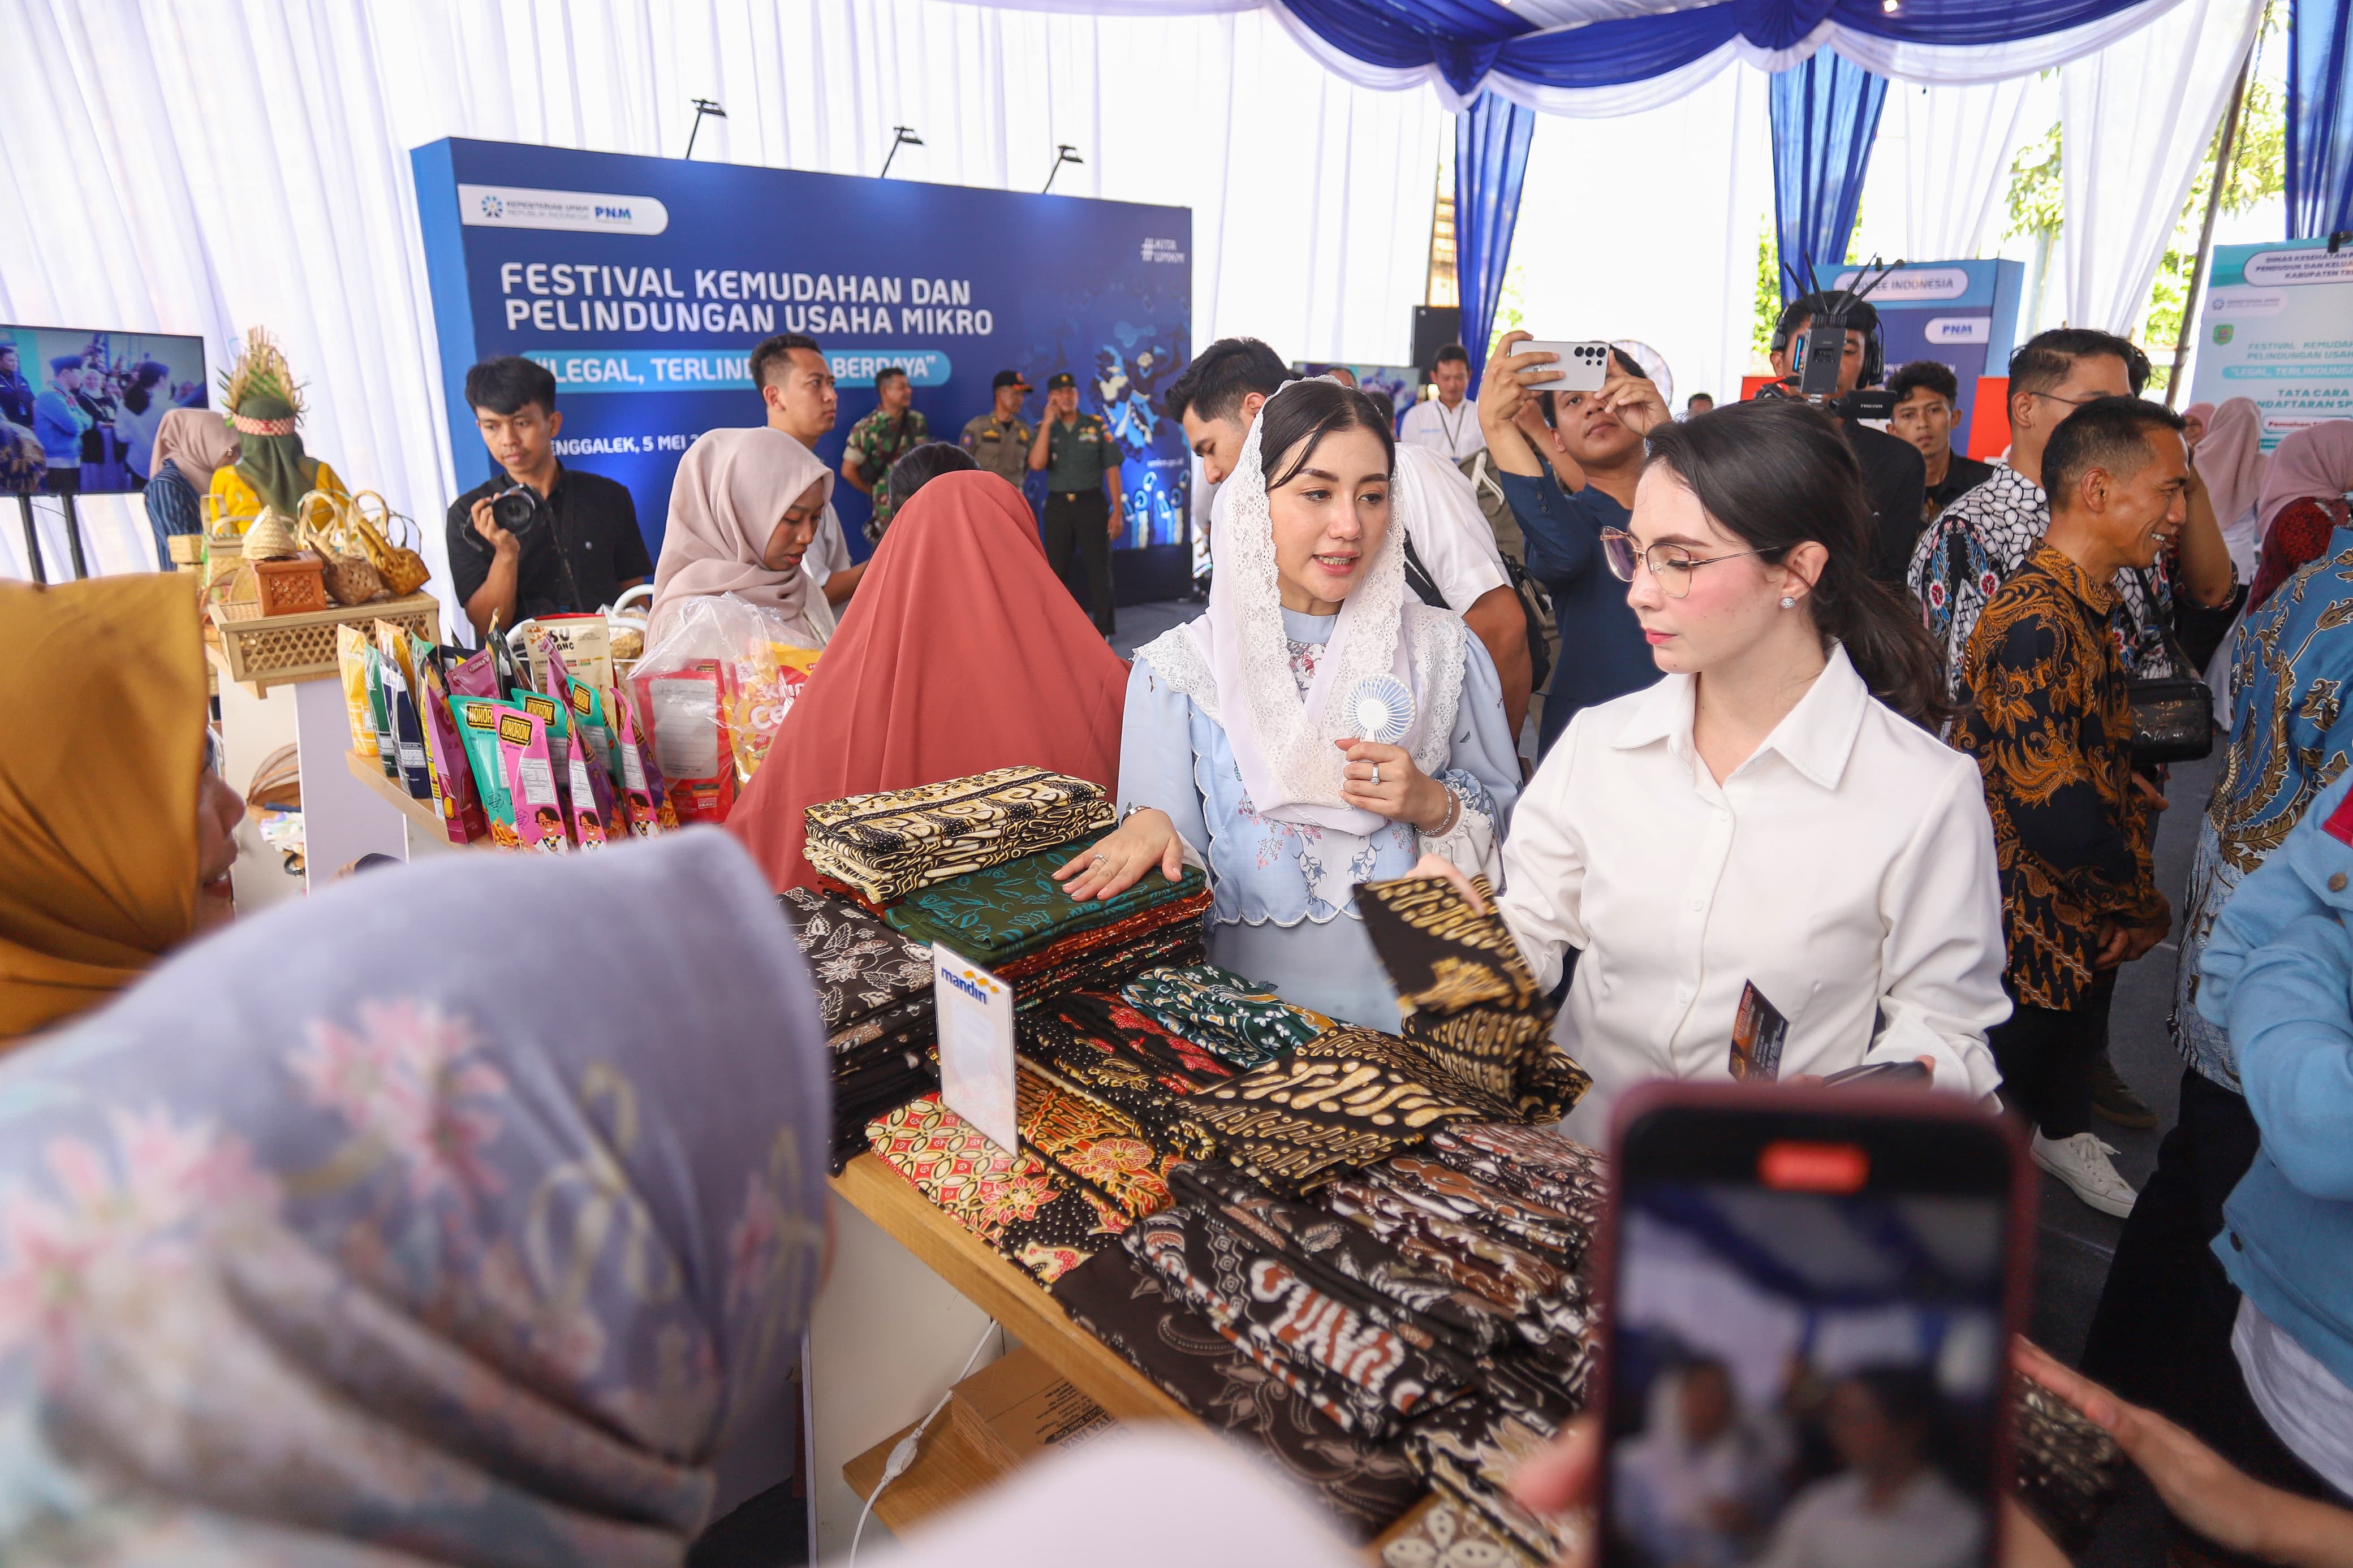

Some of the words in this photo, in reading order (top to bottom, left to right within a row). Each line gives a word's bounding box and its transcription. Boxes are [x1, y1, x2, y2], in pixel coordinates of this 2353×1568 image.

[595, 206, 632, 219] PNM
[2294, 253, 2347, 261] KESEHATAN
[501, 262, 684, 299] FESTIVAL
[695, 269, 902, 304] KEMUDAHAN
[911, 277, 971, 306] DAN
[1891, 278, 1954, 291] INDONESIA
[505, 298, 775, 333] PELINDUNGAN
[785, 304, 894, 334] USAHA
[900, 307, 994, 336] MIKRO
[1942, 324, 1973, 335] PNM
[2303, 340, 2353, 349] KEMUDAH
[2247, 351, 2321, 360] PELINDUNGAN
[2325, 350, 2353, 358] USAH
[650, 356, 753, 382] TERLIND
[2275, 365, 2353, 376] TERLINDUNGI
[2278, 388, 2311, 397] TATA
[2313, 388, 2350, 397] CARA
[551, 436, 640, 456] ENGGALEK,
[643, 435, 654, 452] 5
[657, 434, 686, 451] MEI
[469, 707, 494, 724] KOKOR
[751, 705, 785, 729] Ce
[501, 719, 531, 741] KOKORONI
